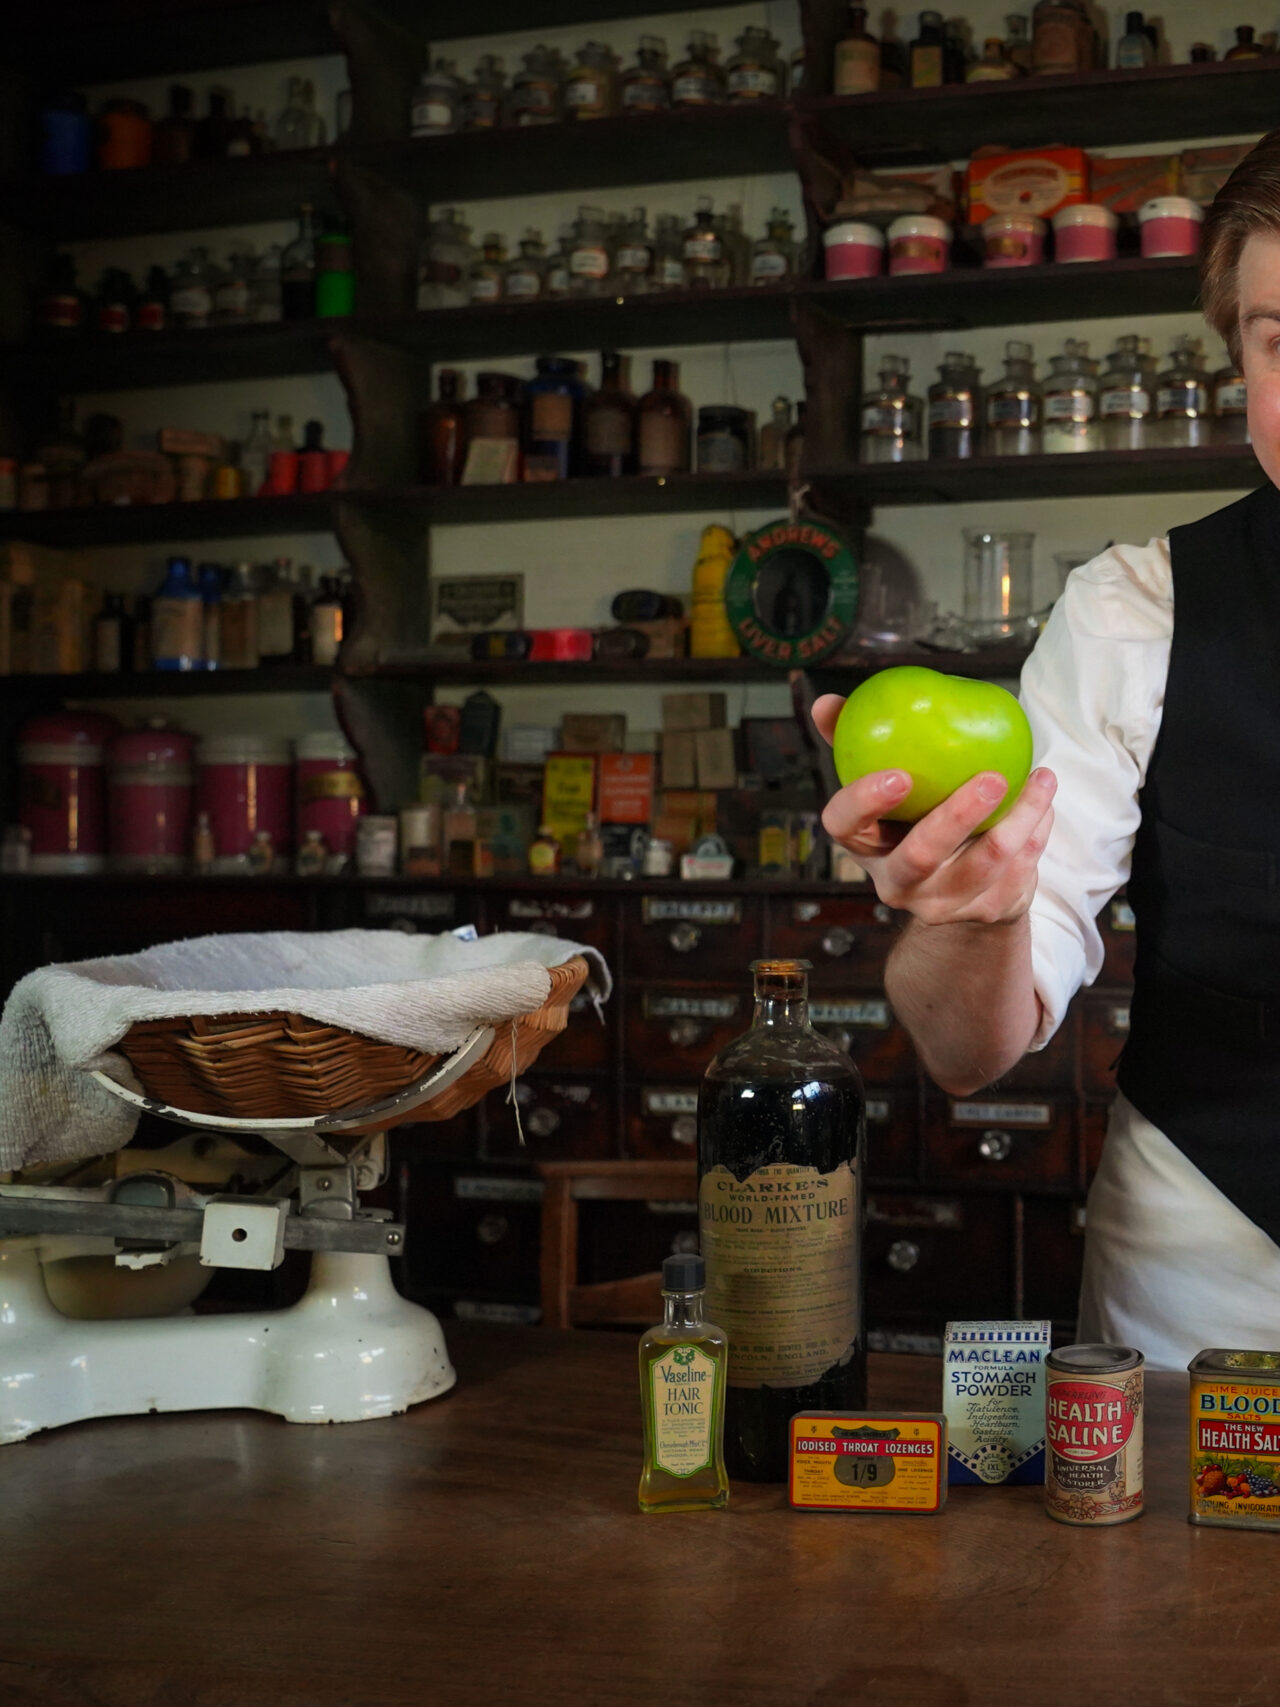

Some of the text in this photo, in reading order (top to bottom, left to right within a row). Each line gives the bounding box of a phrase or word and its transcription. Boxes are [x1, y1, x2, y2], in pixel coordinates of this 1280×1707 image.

[747, 525, 840, 562] ANDREWS
[739, 617, 842, 659] LIVER SALT
[717, 1179, 830, 1193] CLARKE'S
[705, 1197, 849, 1225] BLOOD MIXTURE
[729, 1352, 771, 1362] INCOLN,
[948, 1350, 1042, 1363] MACLEAN
[662, 1365, 707, 1384] Vaseline
[952, 1371, 1037, 1385] STOMACH
[668, 1387, 702, 1402] HAIR
[956, 1384, 1033, 1397] POWDER
[1210, 1385, 1279, 1396] LIME JUICE
[665, 1402, 705, 1416] TONIC
[1049, 1397, 1123, 1423] HEALTH
[1226, 1412, 1262, 1421] SALTS
[1048, 1419, 1125, 1447] SALINE
[1224, 1424, 1264, 1433] THE NEW
[1201, 1428, 1251, 1450] HEALTH
[797, 1440, 934, 1456] IODISED THROAT LOZENGES
[851, 1462, 878, 1483] 1/9
